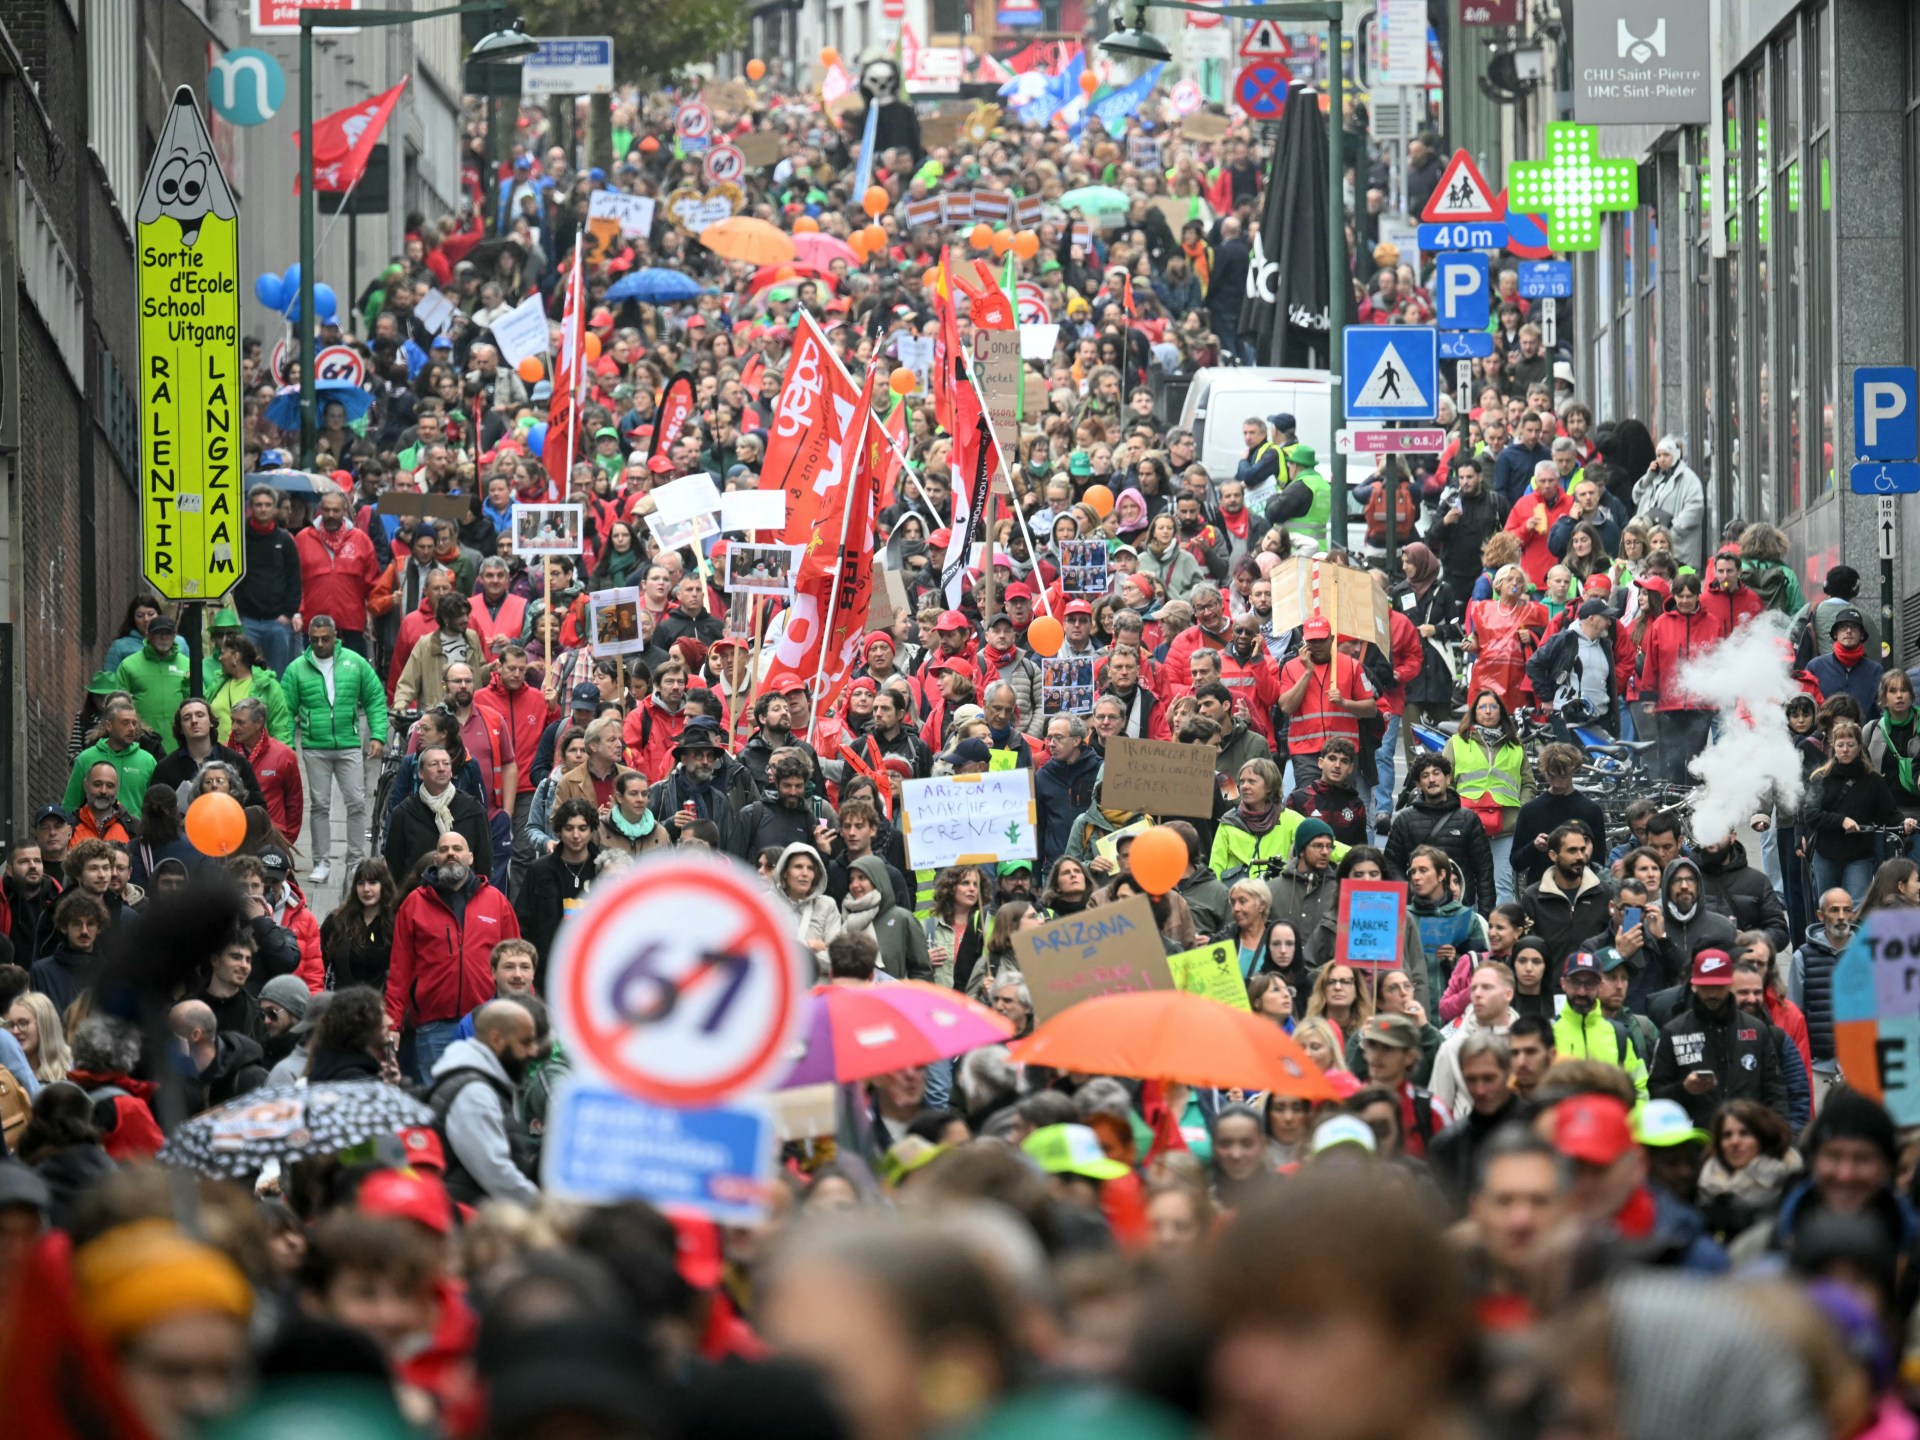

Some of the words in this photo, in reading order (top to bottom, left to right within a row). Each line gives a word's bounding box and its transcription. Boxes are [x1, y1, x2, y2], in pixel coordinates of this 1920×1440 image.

[1583, 68, 1614, 81] CHU
[1617, 67, 1701, 81] Saint-Pierre
[1587, 84, 1620, 98] UMC
[1623, 83, 1697, 98] Sint-Pieter
[1434, 225, 1493, 248] 40m
[143, 246, 204, 268] Sortie
[169, 271, 234, 293] d'Ecole
[1444, 263, 1482, 319] P
[1528, 283, 1546, 296] 07
[1551, 283, 1565, 296] 19
[142, 294, 205, 318] School
[168, 320, 236, 348] Uitgang
[321, 363, 355, 380] 67
[1863, 381, 1907, 447] P
[151, 355, 175, 575] RALENTIR
[206, 355, 235, 574] LANGZAAM
[1881, 499, 1892, 509] 18
[918, 800, 990, 820] MARCHE
[1002, 799, 1024, 811] OU
[920, 817, 1000, 844] CRÈVE
[1351, 918, 1390, 932] MARCHE
[611, 938, 754, 1037] 67
